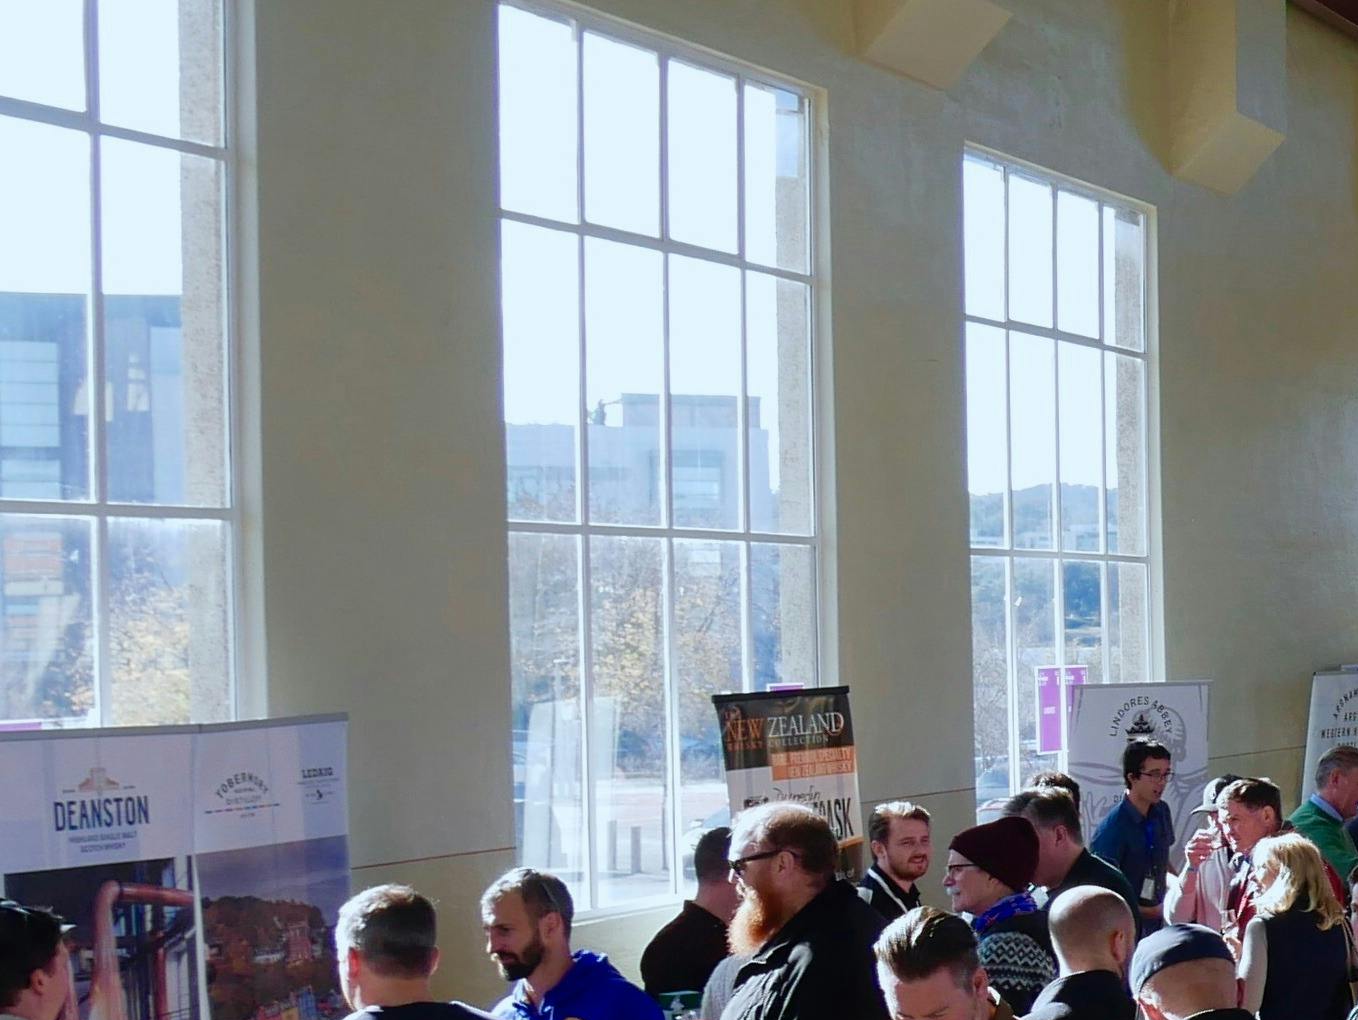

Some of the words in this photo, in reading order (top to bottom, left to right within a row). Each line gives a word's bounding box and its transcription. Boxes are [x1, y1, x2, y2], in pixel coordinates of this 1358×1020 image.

[726, 717, 764, 743] NEW
[767, 711, 844, 738] ZEALAND
[1109, 696, 1150, 737] LINDORES
[53, 795, 151, 832] DEANSTON
